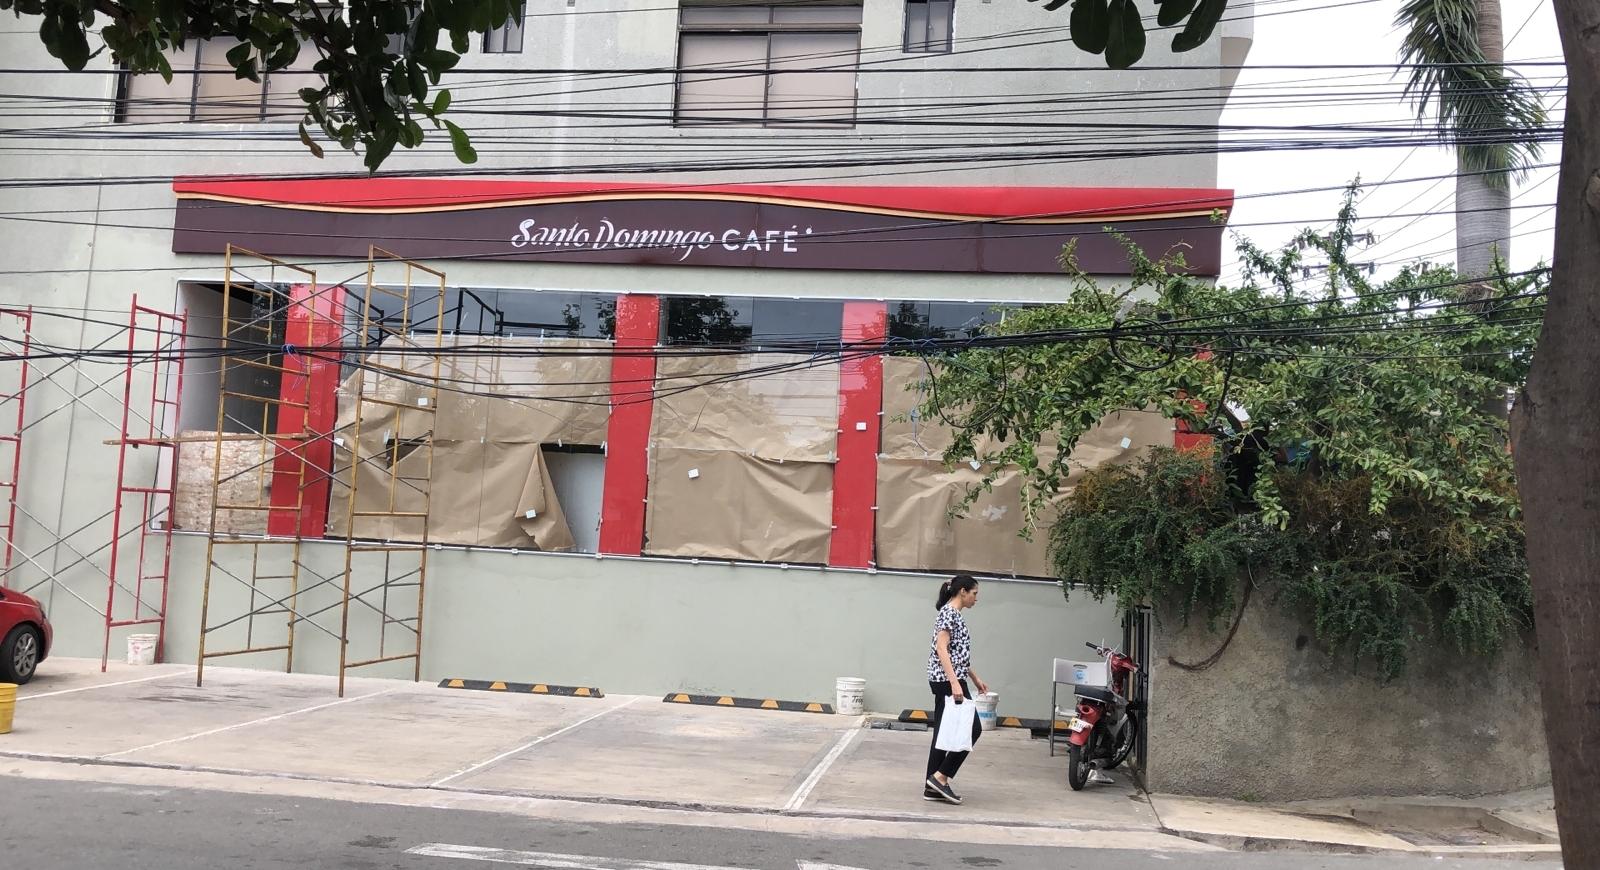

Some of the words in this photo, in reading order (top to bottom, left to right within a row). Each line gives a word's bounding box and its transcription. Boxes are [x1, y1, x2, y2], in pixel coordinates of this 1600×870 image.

[511, 219, 590, 248] Santo
[593, 219, 715, 261] Domingo
[721, 224, 799, 252] CAFÉ
